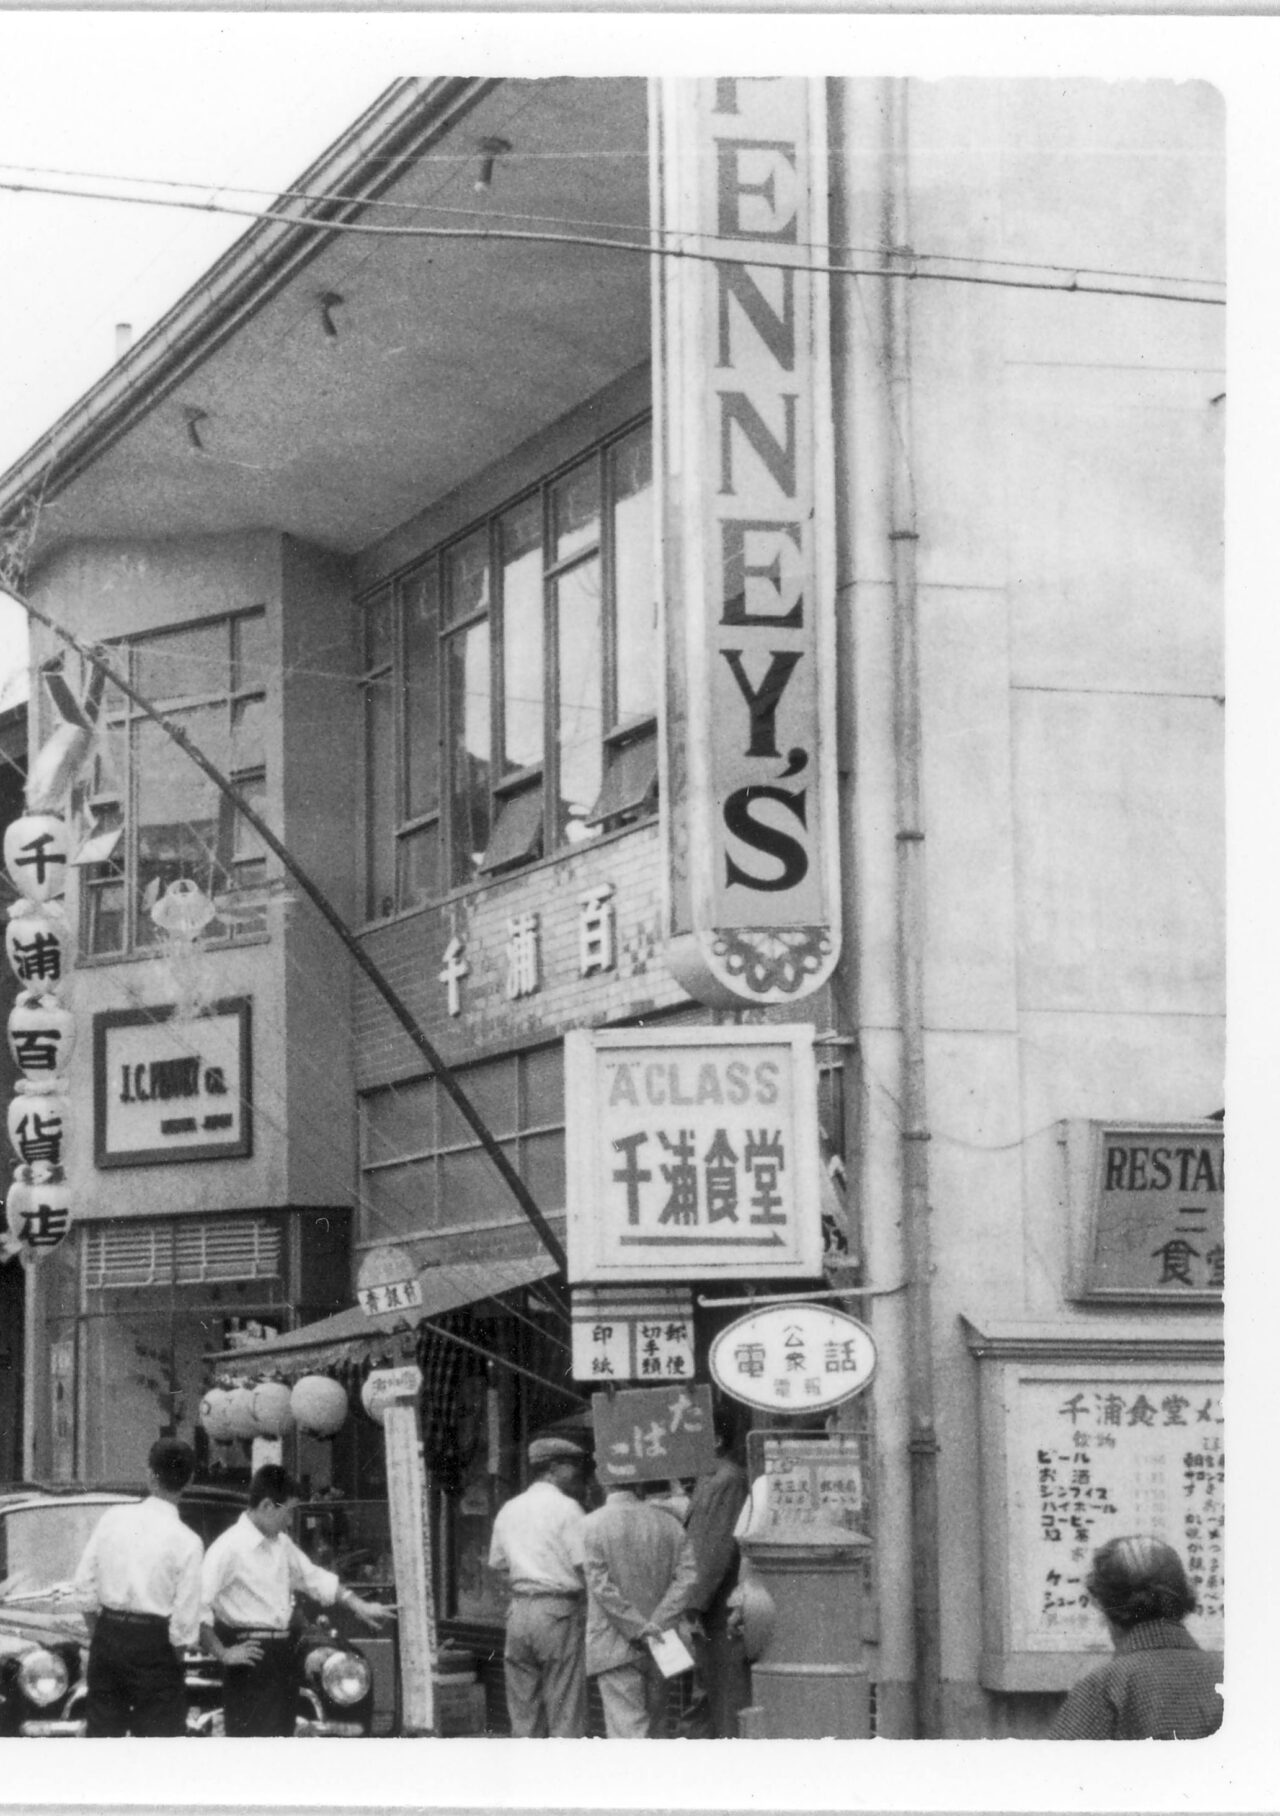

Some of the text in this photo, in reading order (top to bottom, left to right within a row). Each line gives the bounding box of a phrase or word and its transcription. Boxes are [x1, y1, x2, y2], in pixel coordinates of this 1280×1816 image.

[12, 832, 69, 1248] 千浦百貨店
[646, 1061, 780, 1106] CLASS
[612, 1129, 787, 1226] 千浦食堂
[1105, 1146, 1224, 1191] RESTA
[592, 1325, 614, 1376] 印紙
